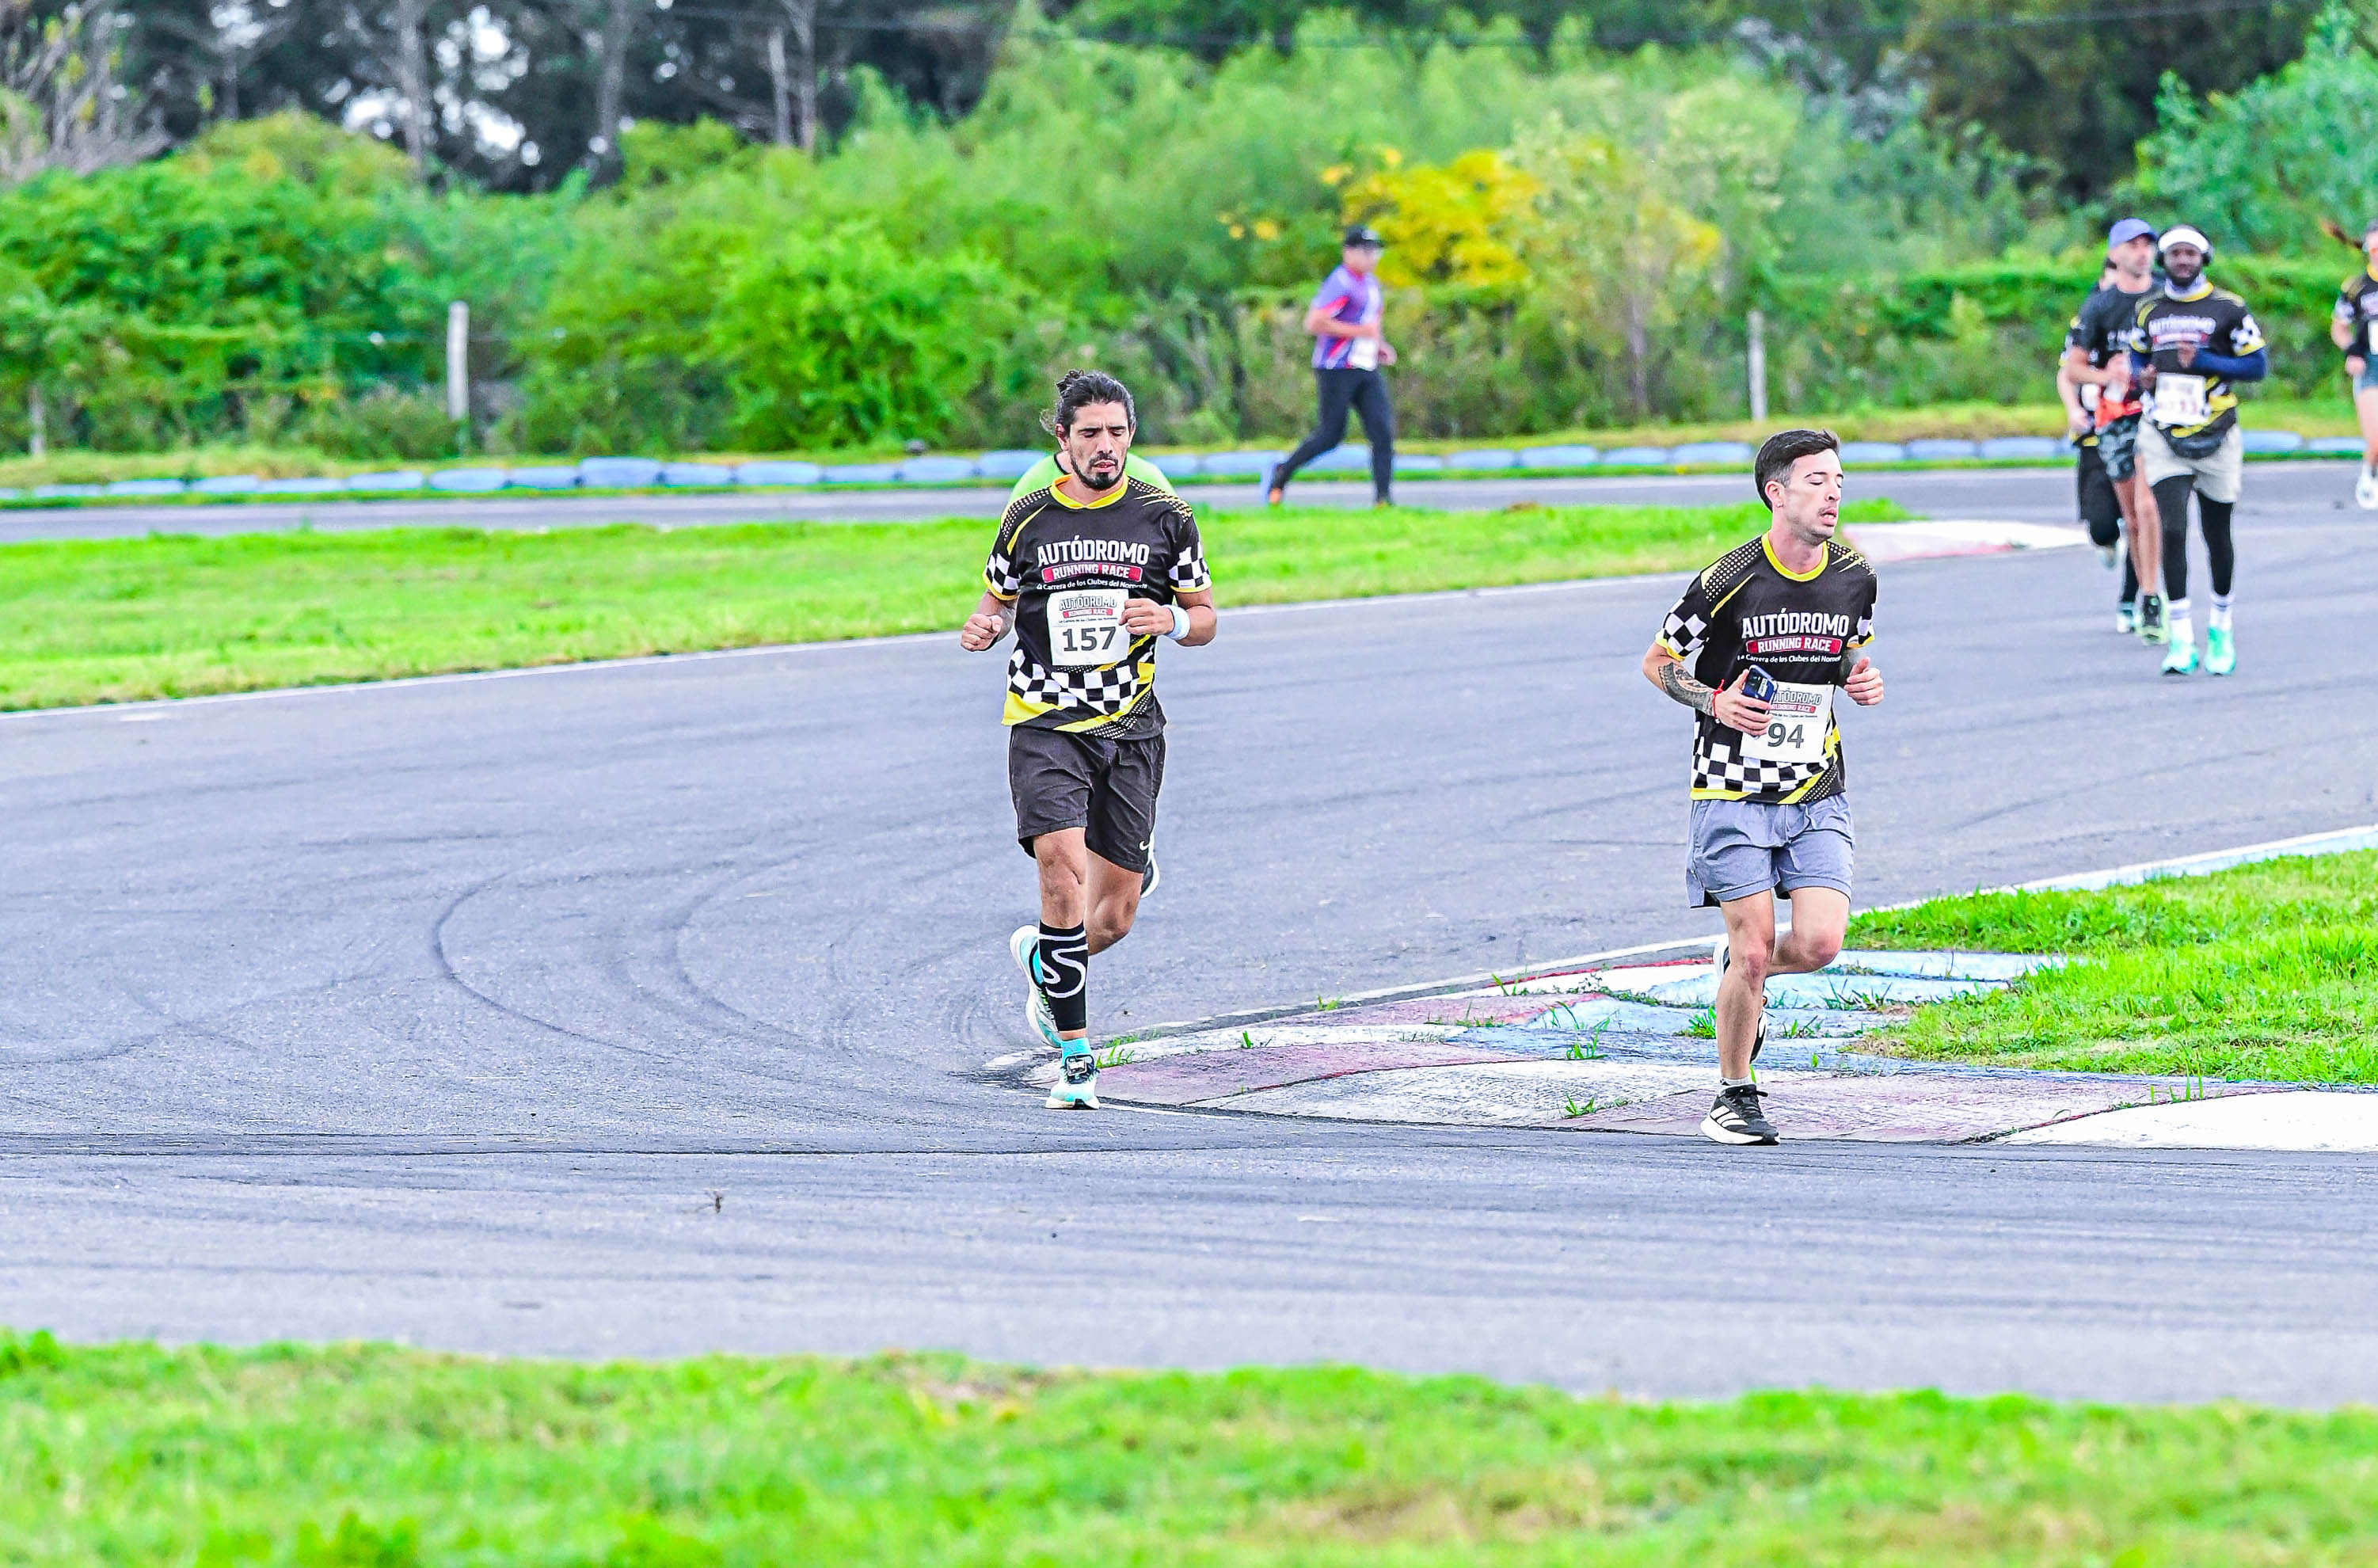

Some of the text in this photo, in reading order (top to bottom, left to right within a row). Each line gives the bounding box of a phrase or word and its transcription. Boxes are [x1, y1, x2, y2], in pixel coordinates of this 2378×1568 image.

[1037, 535, 1150, 567] AUTÓDROMO
[1052, 564, 1131, 579] RUNNING RACE
[1060, 594, 1117, 611] AUTÓDROMO
[1741, 607, 1849, 638] AUTÓDROMO
[1063, 626, 1117, 651] 157
[1757, 637, 1832, 653] RUNNING RACE
[1745, 654, 1769, 663] Carrera
